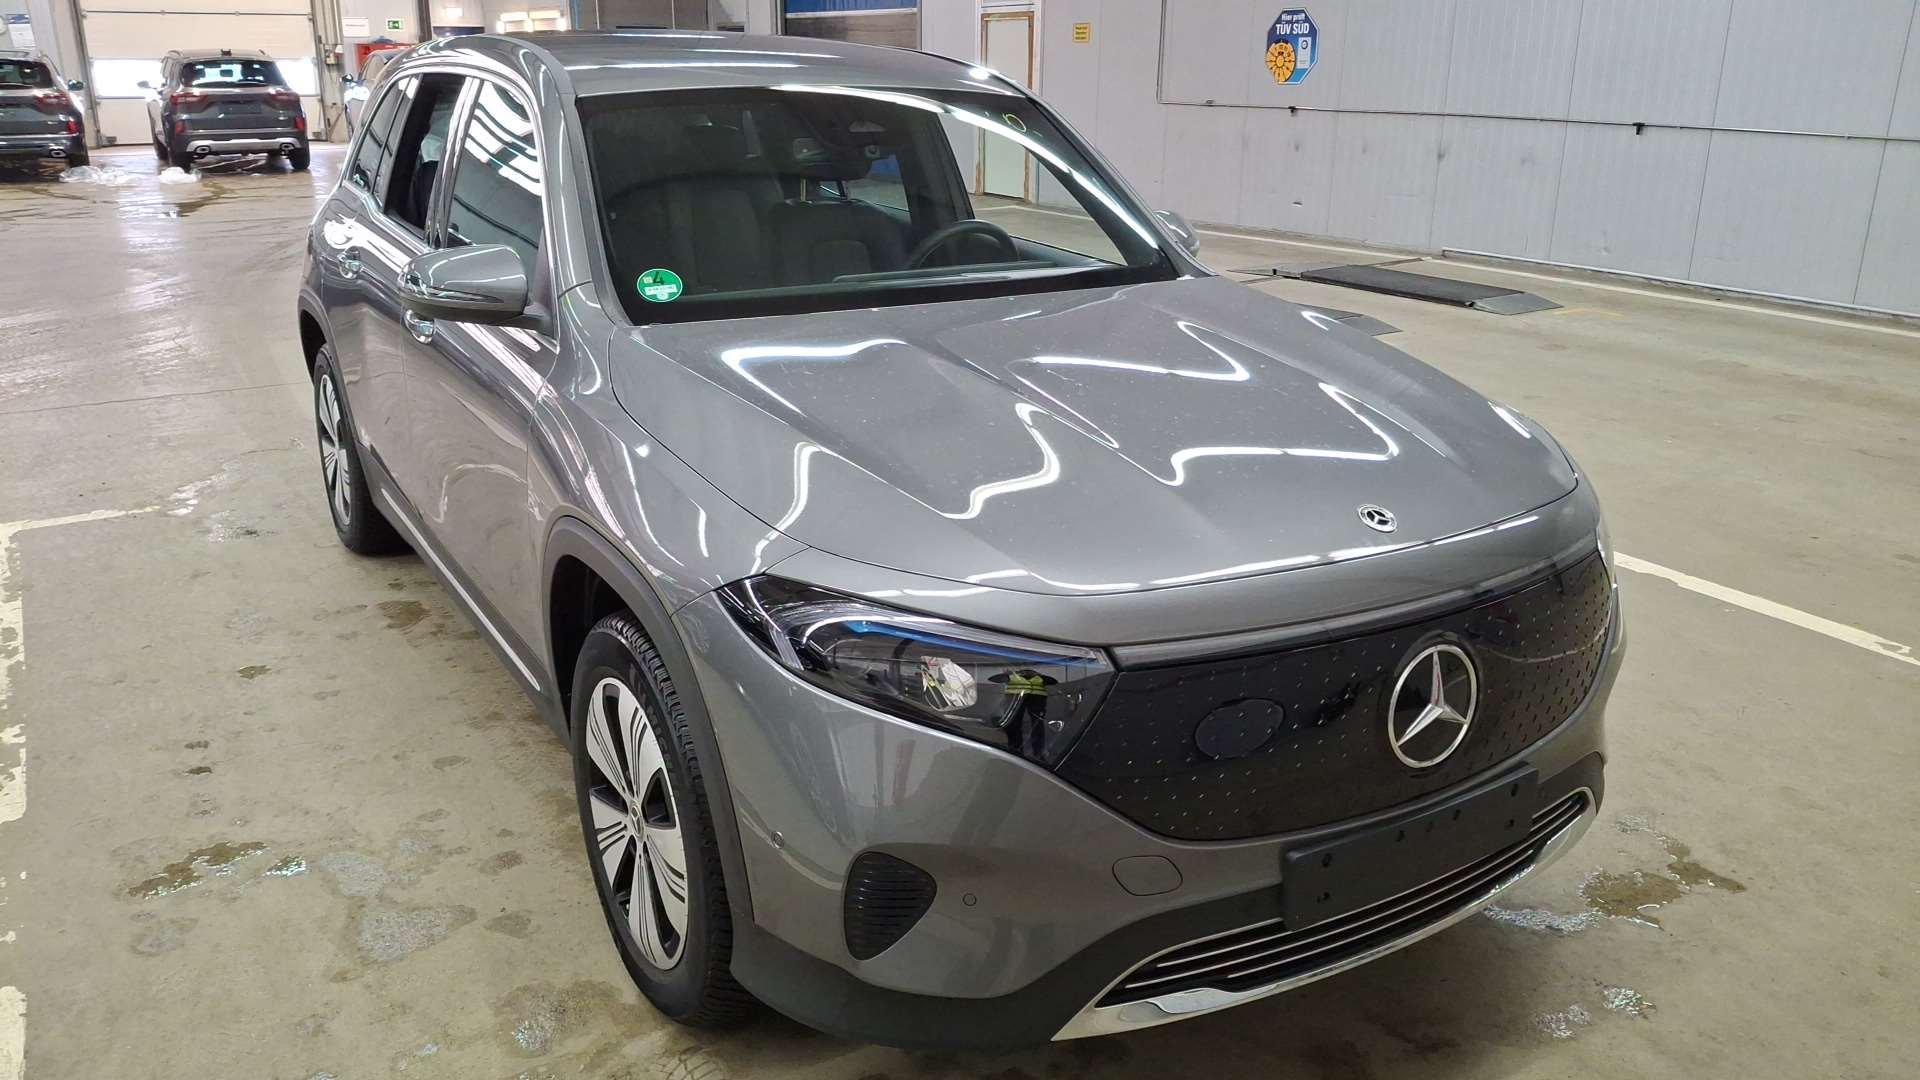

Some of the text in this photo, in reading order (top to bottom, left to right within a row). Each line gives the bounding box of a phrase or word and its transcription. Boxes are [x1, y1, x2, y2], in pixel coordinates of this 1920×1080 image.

[1276, 21, 1310, 35] TÜV SÜD
[653, 271, 665, 285] 4
